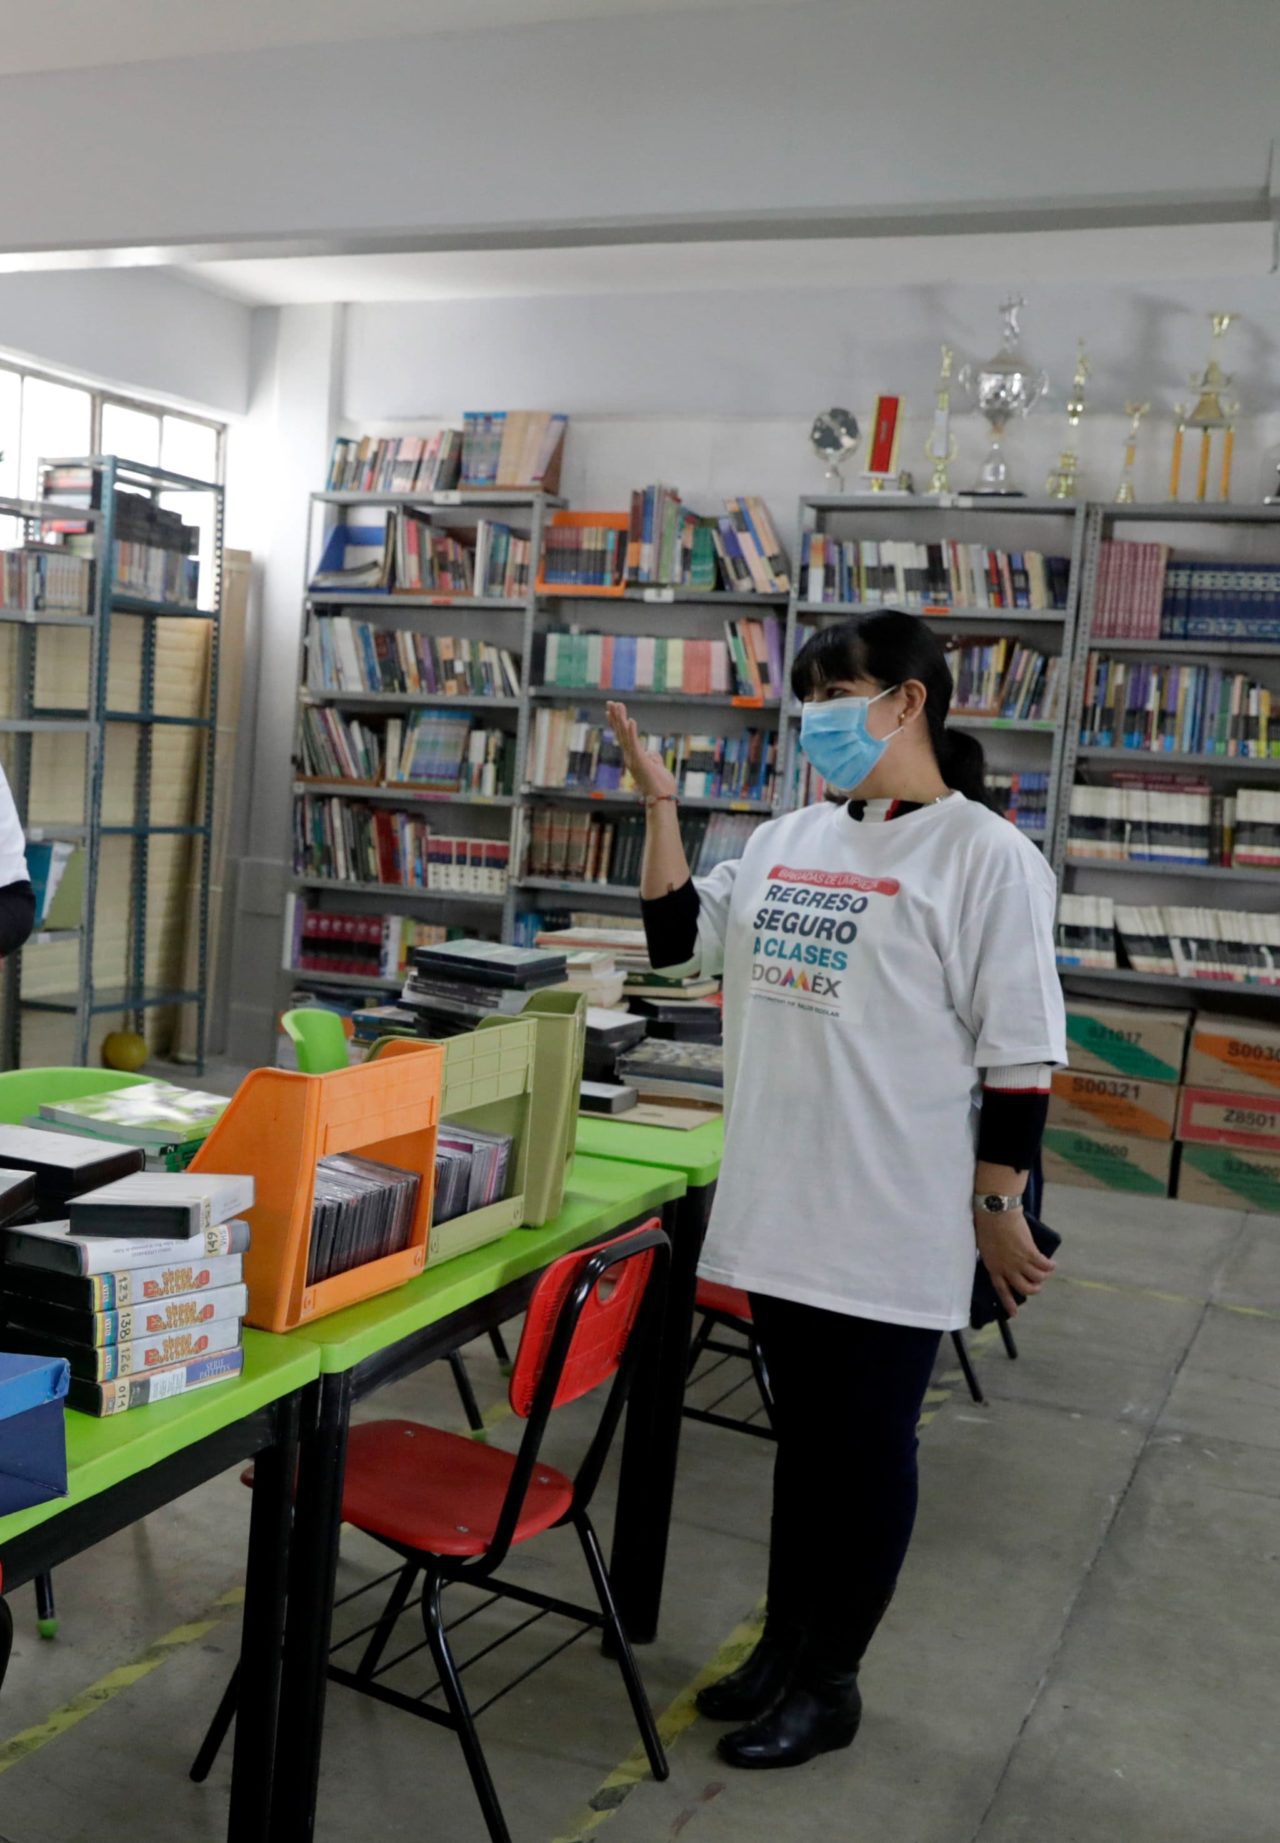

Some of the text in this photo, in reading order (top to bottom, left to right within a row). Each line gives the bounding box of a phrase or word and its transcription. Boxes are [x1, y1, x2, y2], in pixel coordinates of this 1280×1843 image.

[765, 884, 868, 914] REGRESO
[753, 908, 857, 944] SEGURO
[764, 938, 848, 971] CLASES
[1072, 1077, 1140, 1099] S00321
[119, 1313, 131, 1339] 138
